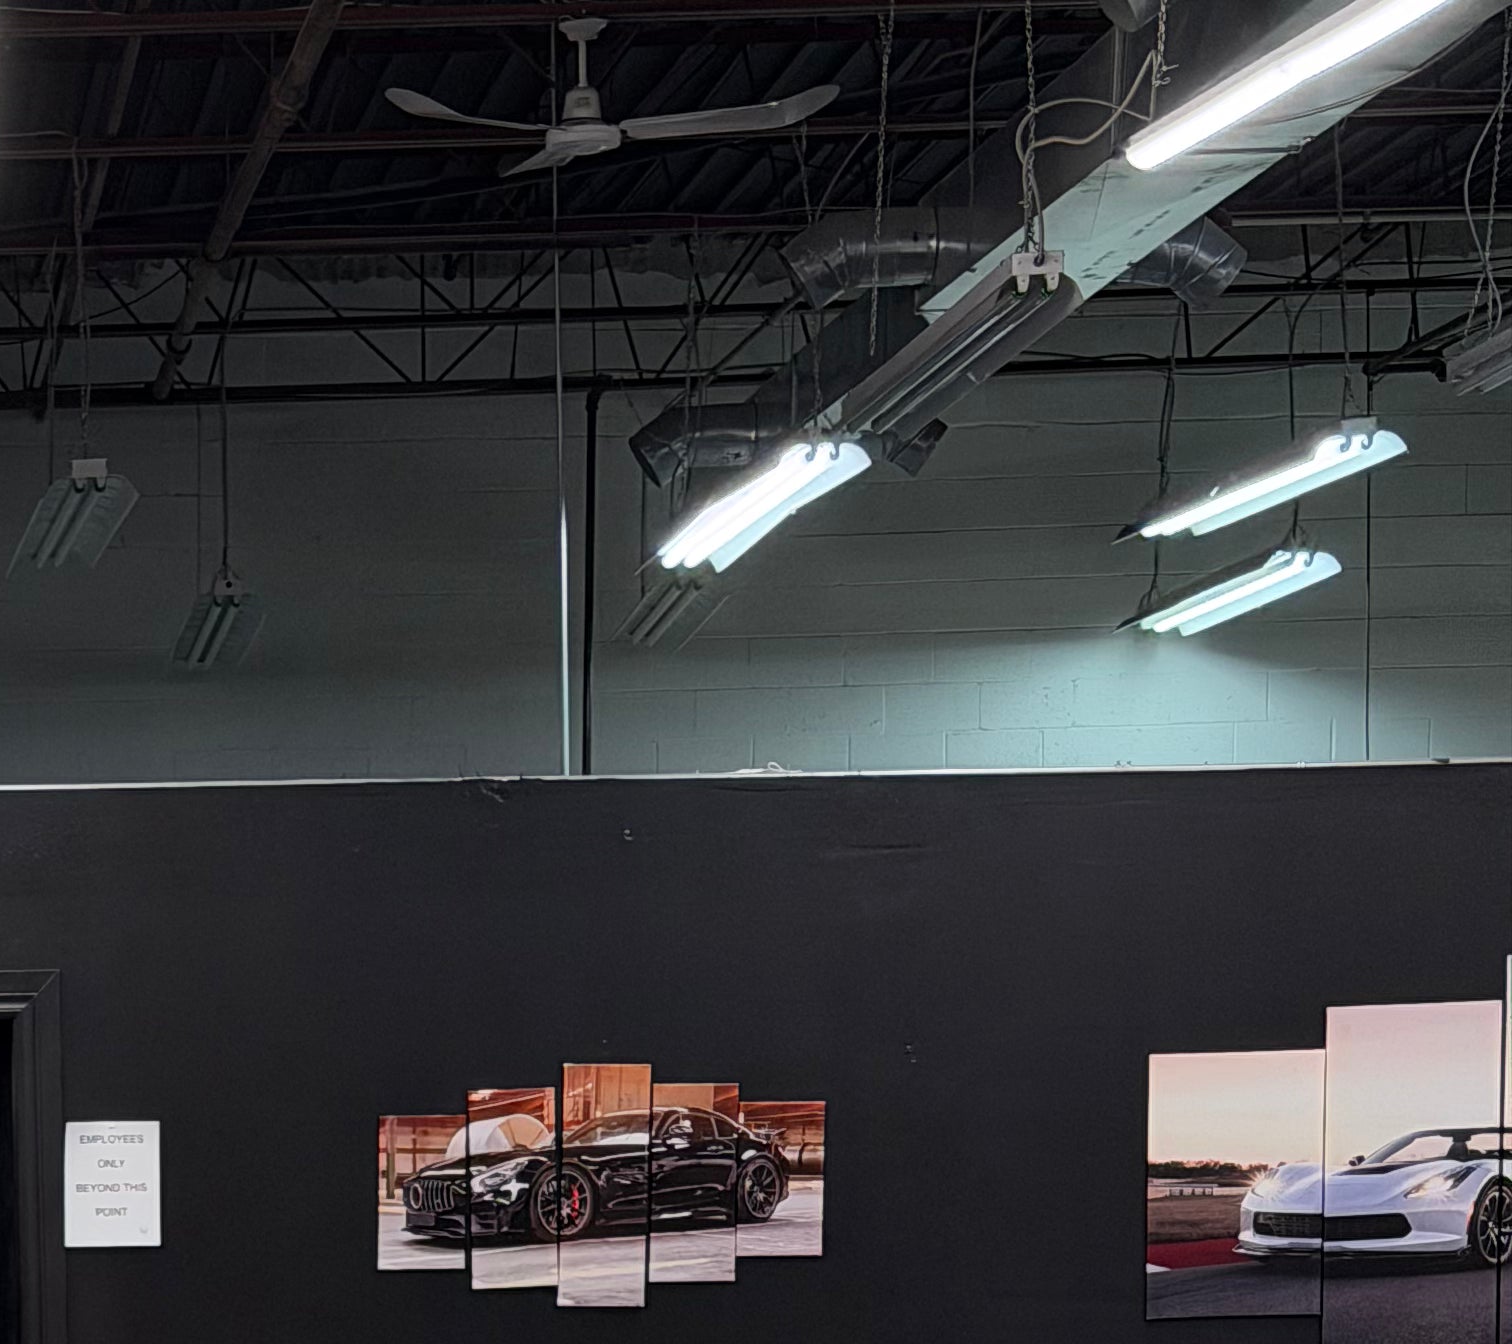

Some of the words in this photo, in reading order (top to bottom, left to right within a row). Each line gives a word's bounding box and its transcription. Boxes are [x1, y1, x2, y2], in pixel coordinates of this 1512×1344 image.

[79, 1134, 144, 1144] EMPLOYEES
[97, 1159, 125, 1168] ONLY
[76, 1183, 120, 1193] BEYOND
[124, 1182, 147, 1192] THIS
[95, 1207, 128, 1217] POINT
